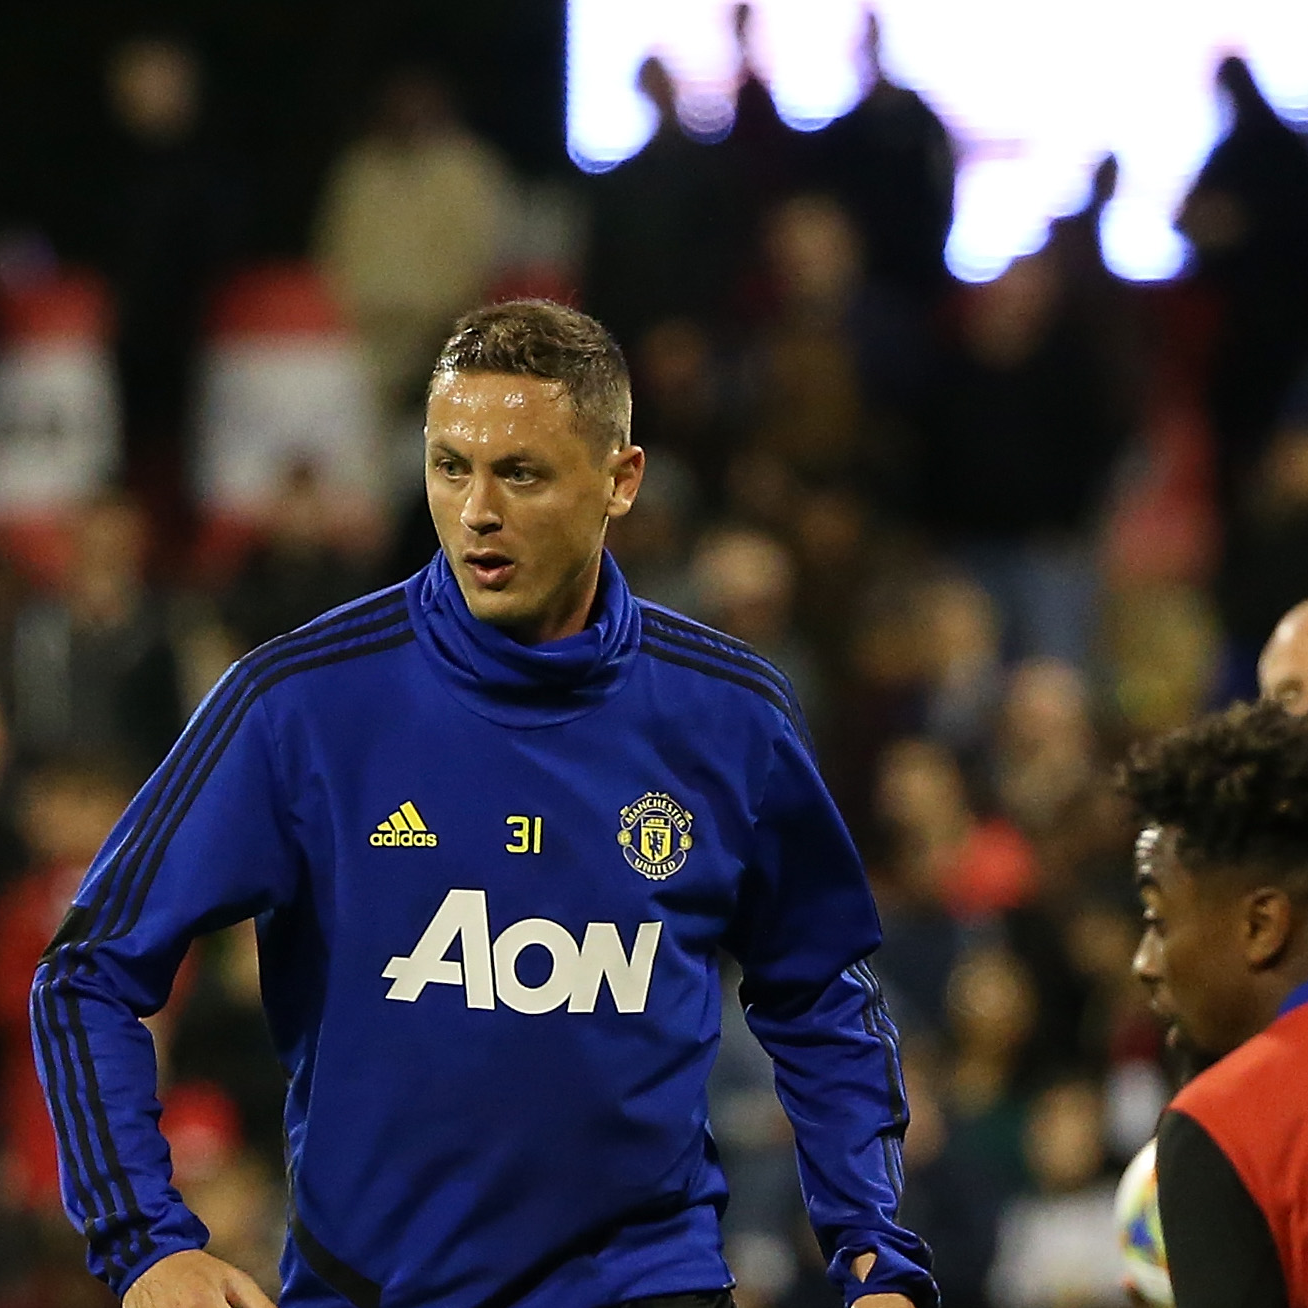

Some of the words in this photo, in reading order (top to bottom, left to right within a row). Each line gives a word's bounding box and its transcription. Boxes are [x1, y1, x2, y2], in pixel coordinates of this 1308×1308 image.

[624, 798, 687, 829] MANCHESTER
[369, 830, 438, 848] adidas
[505, 815, 543, 854] 31
[634, 858, 677, 874] UNITED
